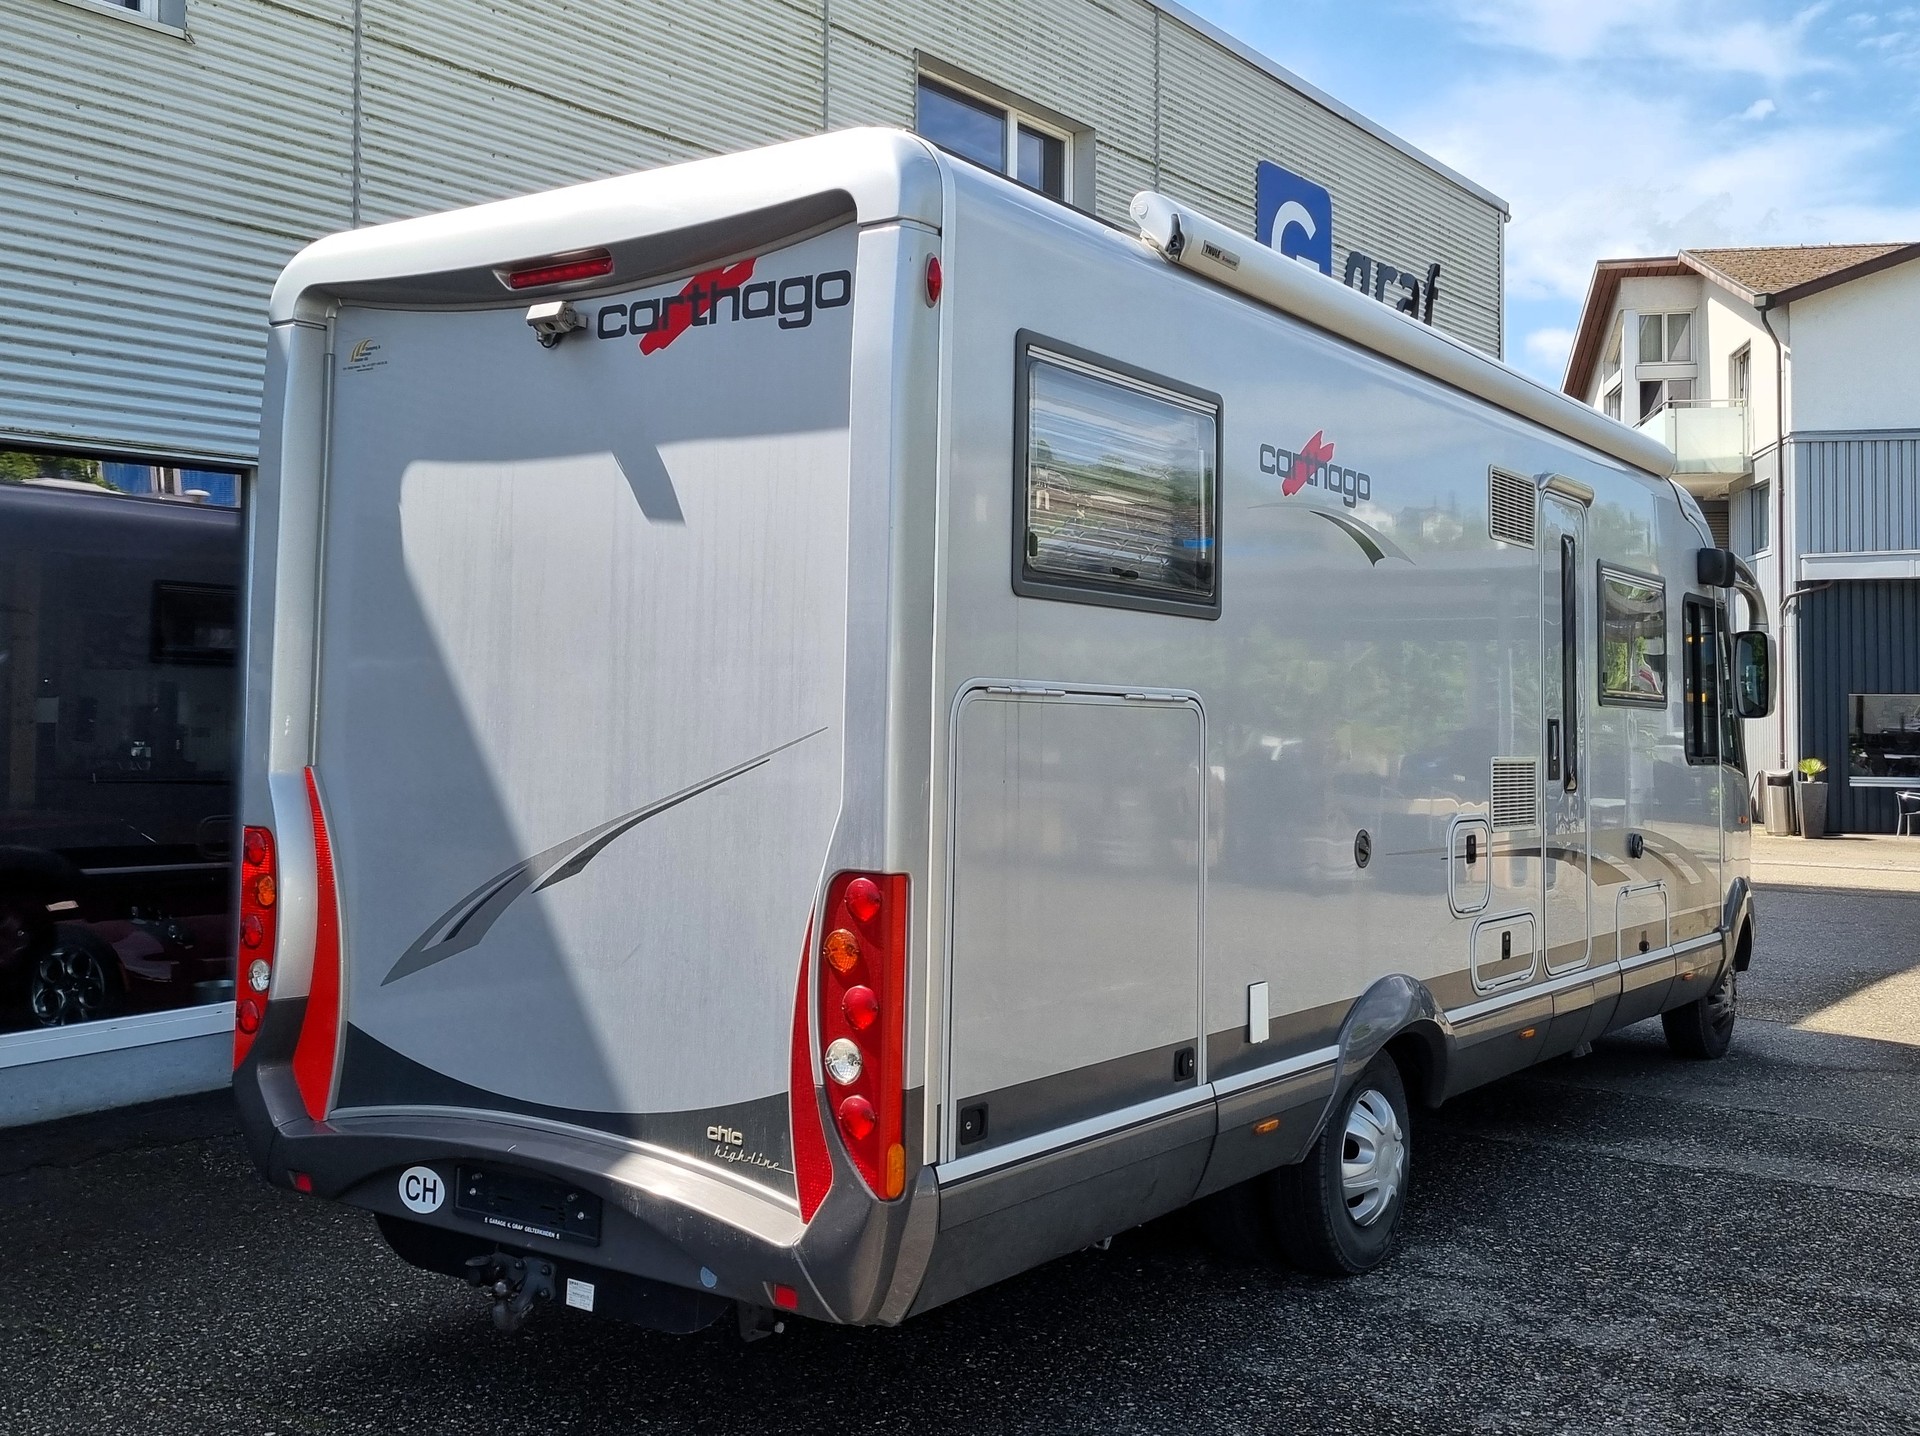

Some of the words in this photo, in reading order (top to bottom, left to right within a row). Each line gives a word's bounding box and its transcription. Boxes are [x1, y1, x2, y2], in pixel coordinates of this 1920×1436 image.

[597, 269, 851, 339] carthago
[1259, 443, 1371, 508] carthago
[707, 1125, 742, 1145] chic
[405, 1175, 437, 1205] CH
[489, 1217, 506, 1227] GARAGE
[512, 1223, 523, 1231] GRAF
